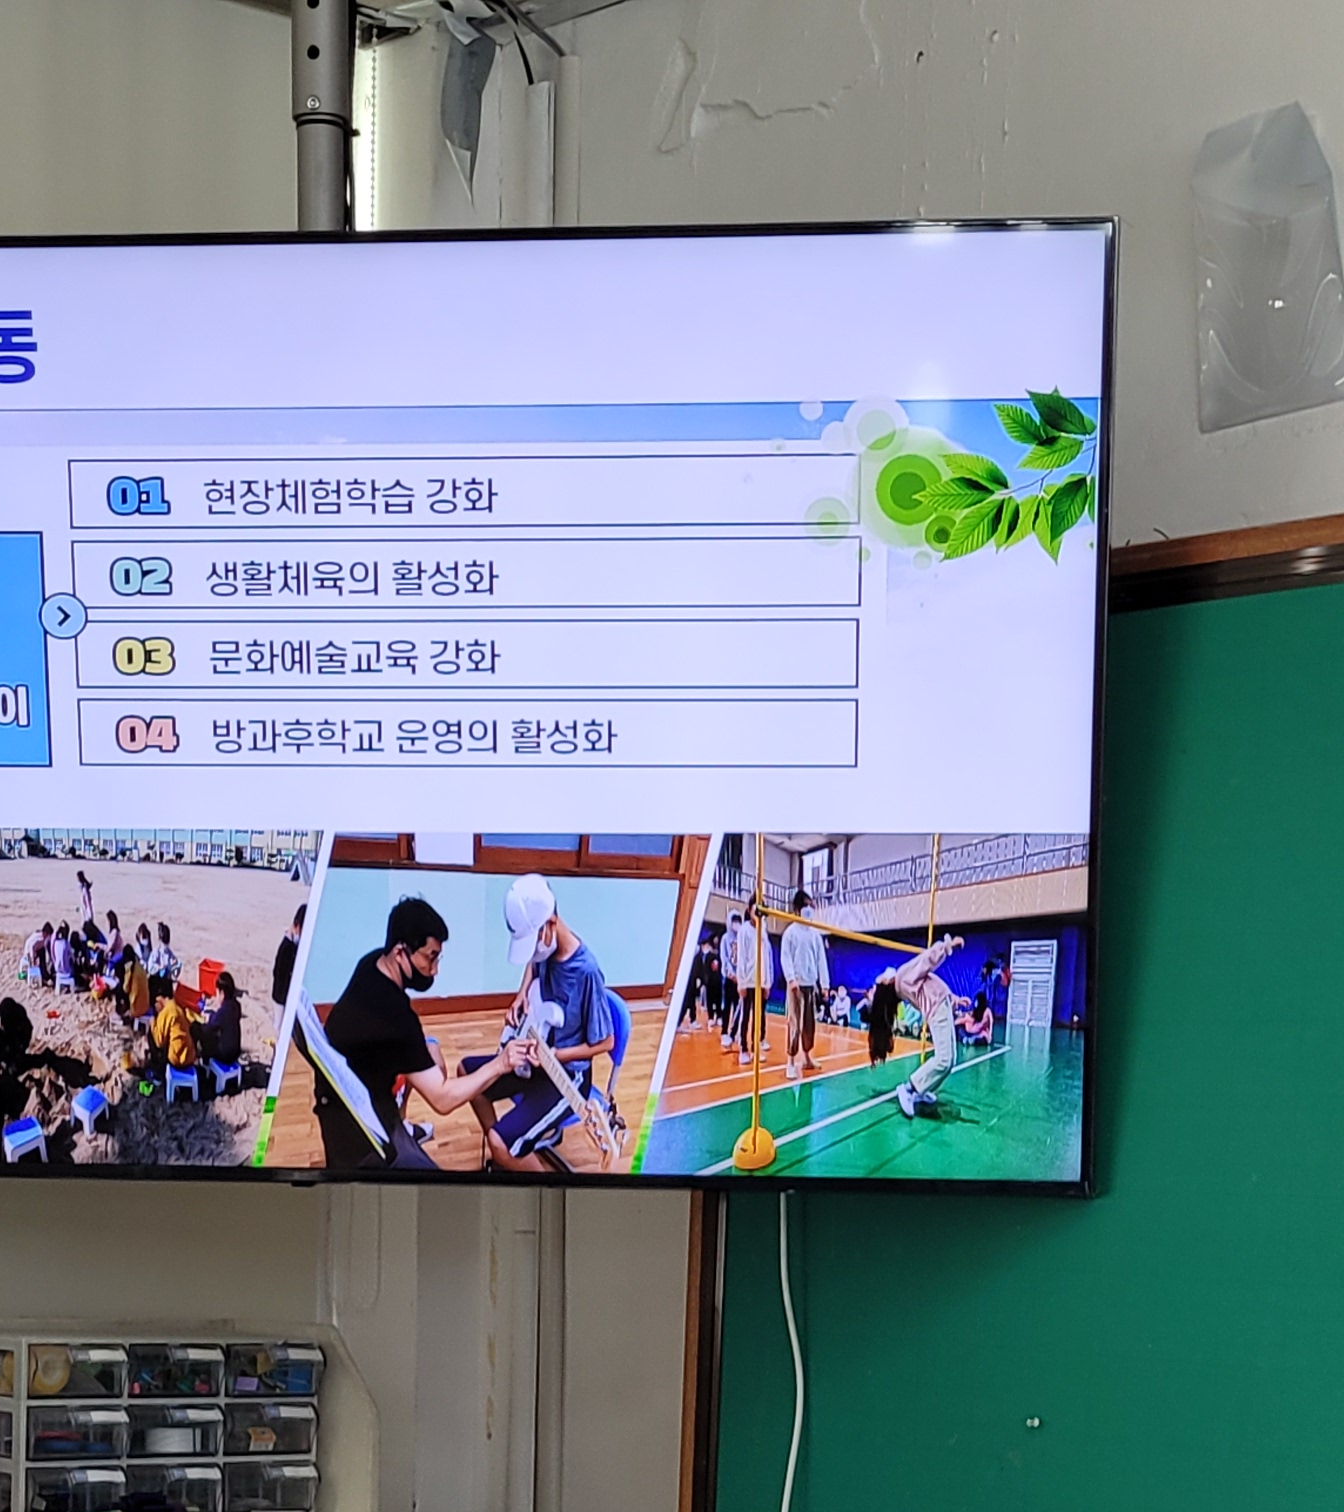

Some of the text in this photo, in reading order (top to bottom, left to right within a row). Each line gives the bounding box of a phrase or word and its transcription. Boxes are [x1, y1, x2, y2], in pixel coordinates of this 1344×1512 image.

[106, 476, 499, 517] 01 현장체험학습 강화
[109, 557, 500, 597] 02 생활체육의 활성화
[112, 637, 502, 676] 03 문화예술교육 강화
[115, 715, 619, 755] 04 방과후학교 운영의 활성화
